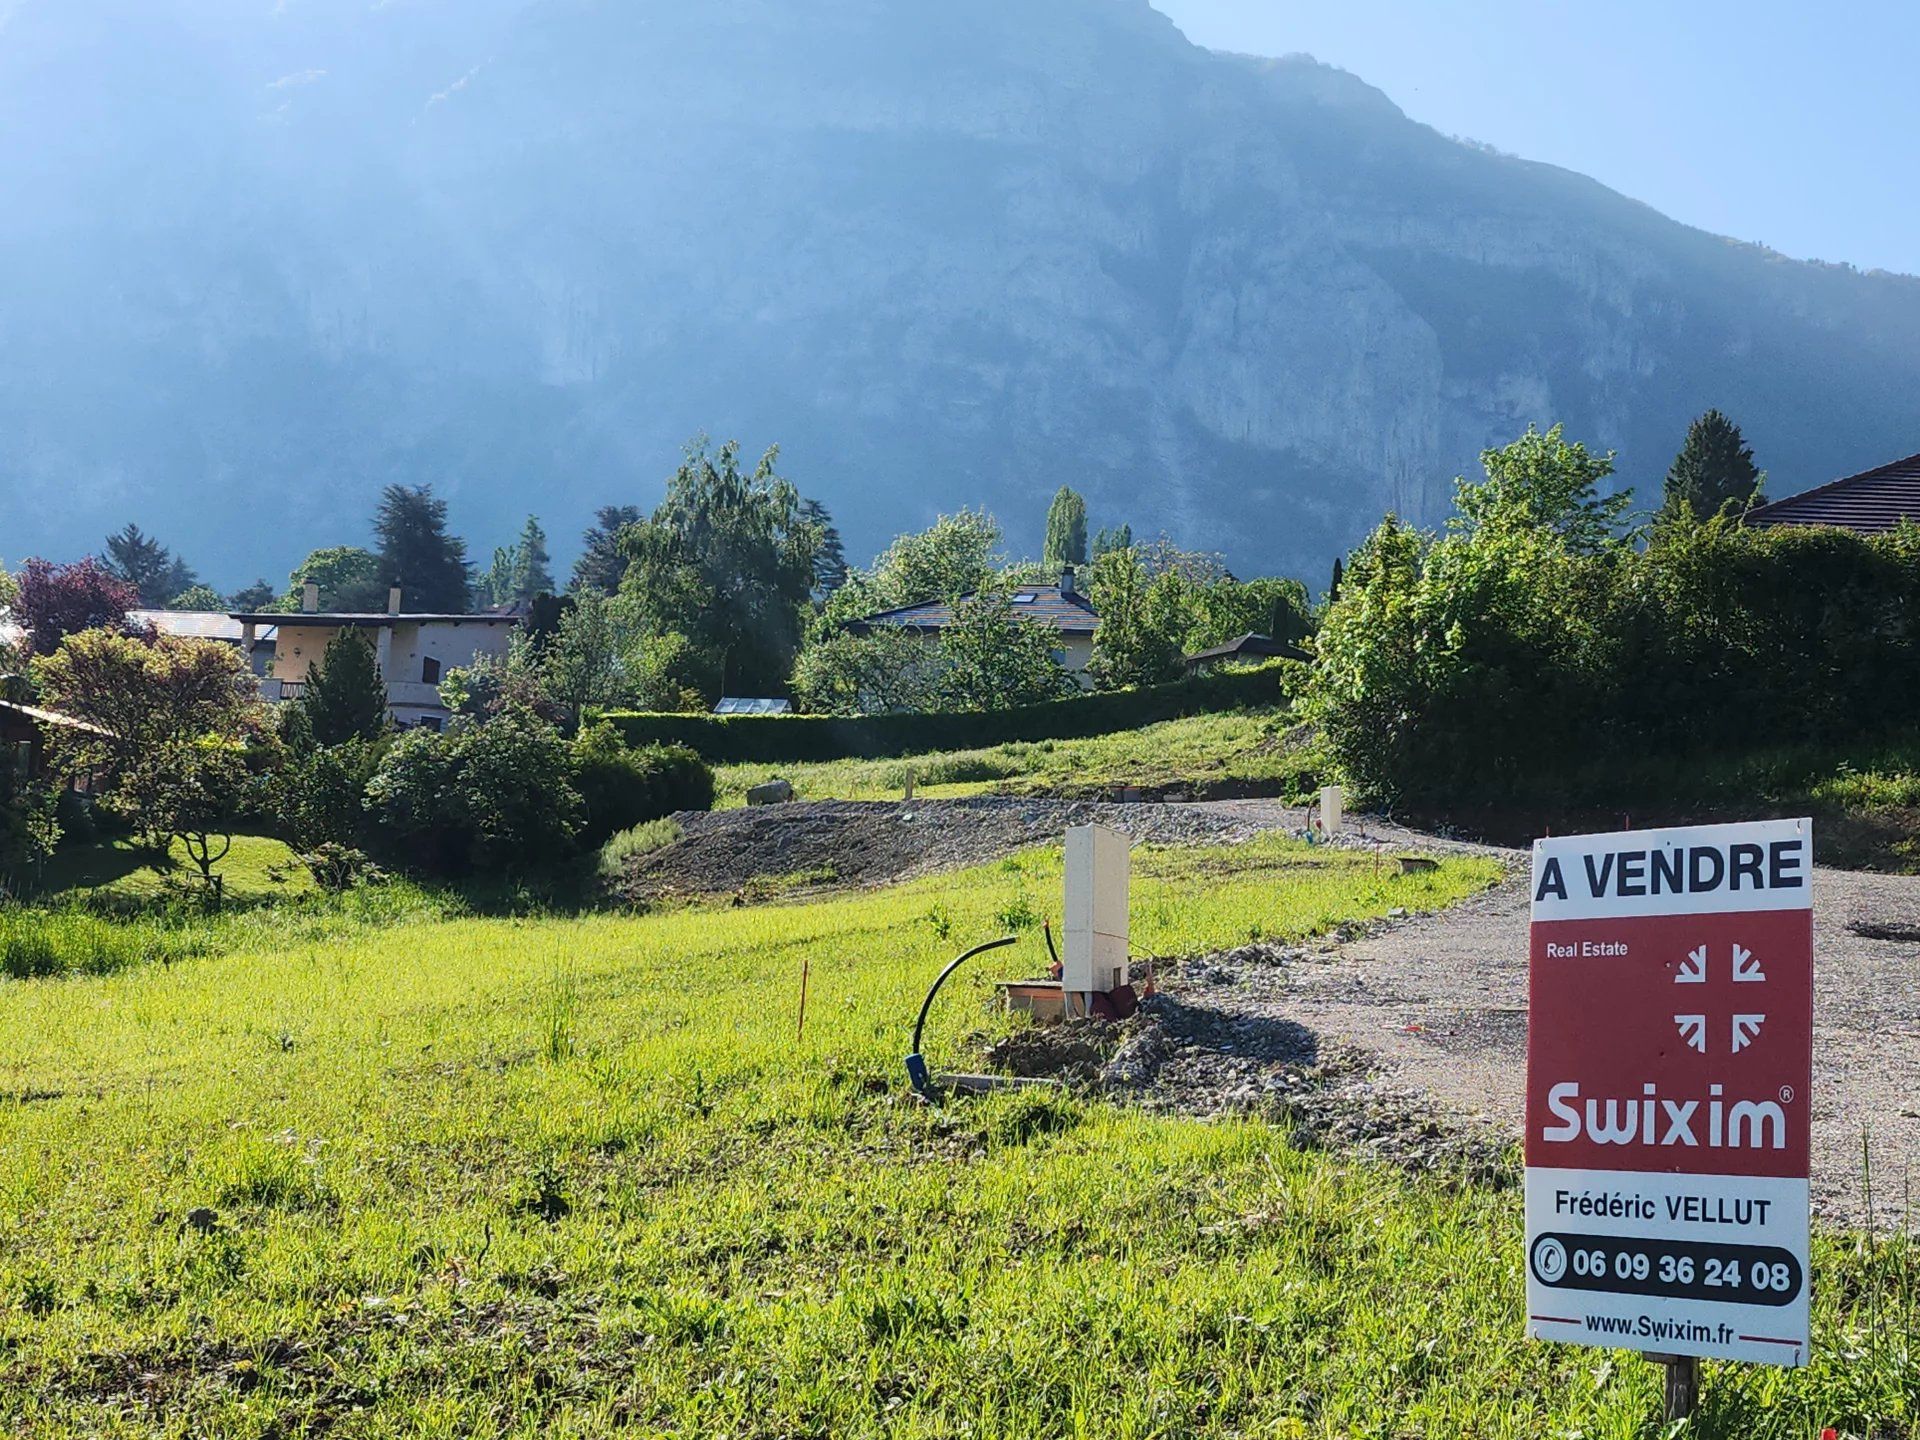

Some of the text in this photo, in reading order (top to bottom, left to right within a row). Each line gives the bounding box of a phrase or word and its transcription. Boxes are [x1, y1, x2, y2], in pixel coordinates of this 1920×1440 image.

[1534, 840, 1803, 901] A VENDRE
[1547, 940, 1628, 958] Real Estate
[1555, 1190, 1771, 1225] Frédéric VELLUT
[1572, 1249, 1790, 1292] 06 09 36 24 08
[1585, 1314, 1734, 1345] www.Swixim.fr
